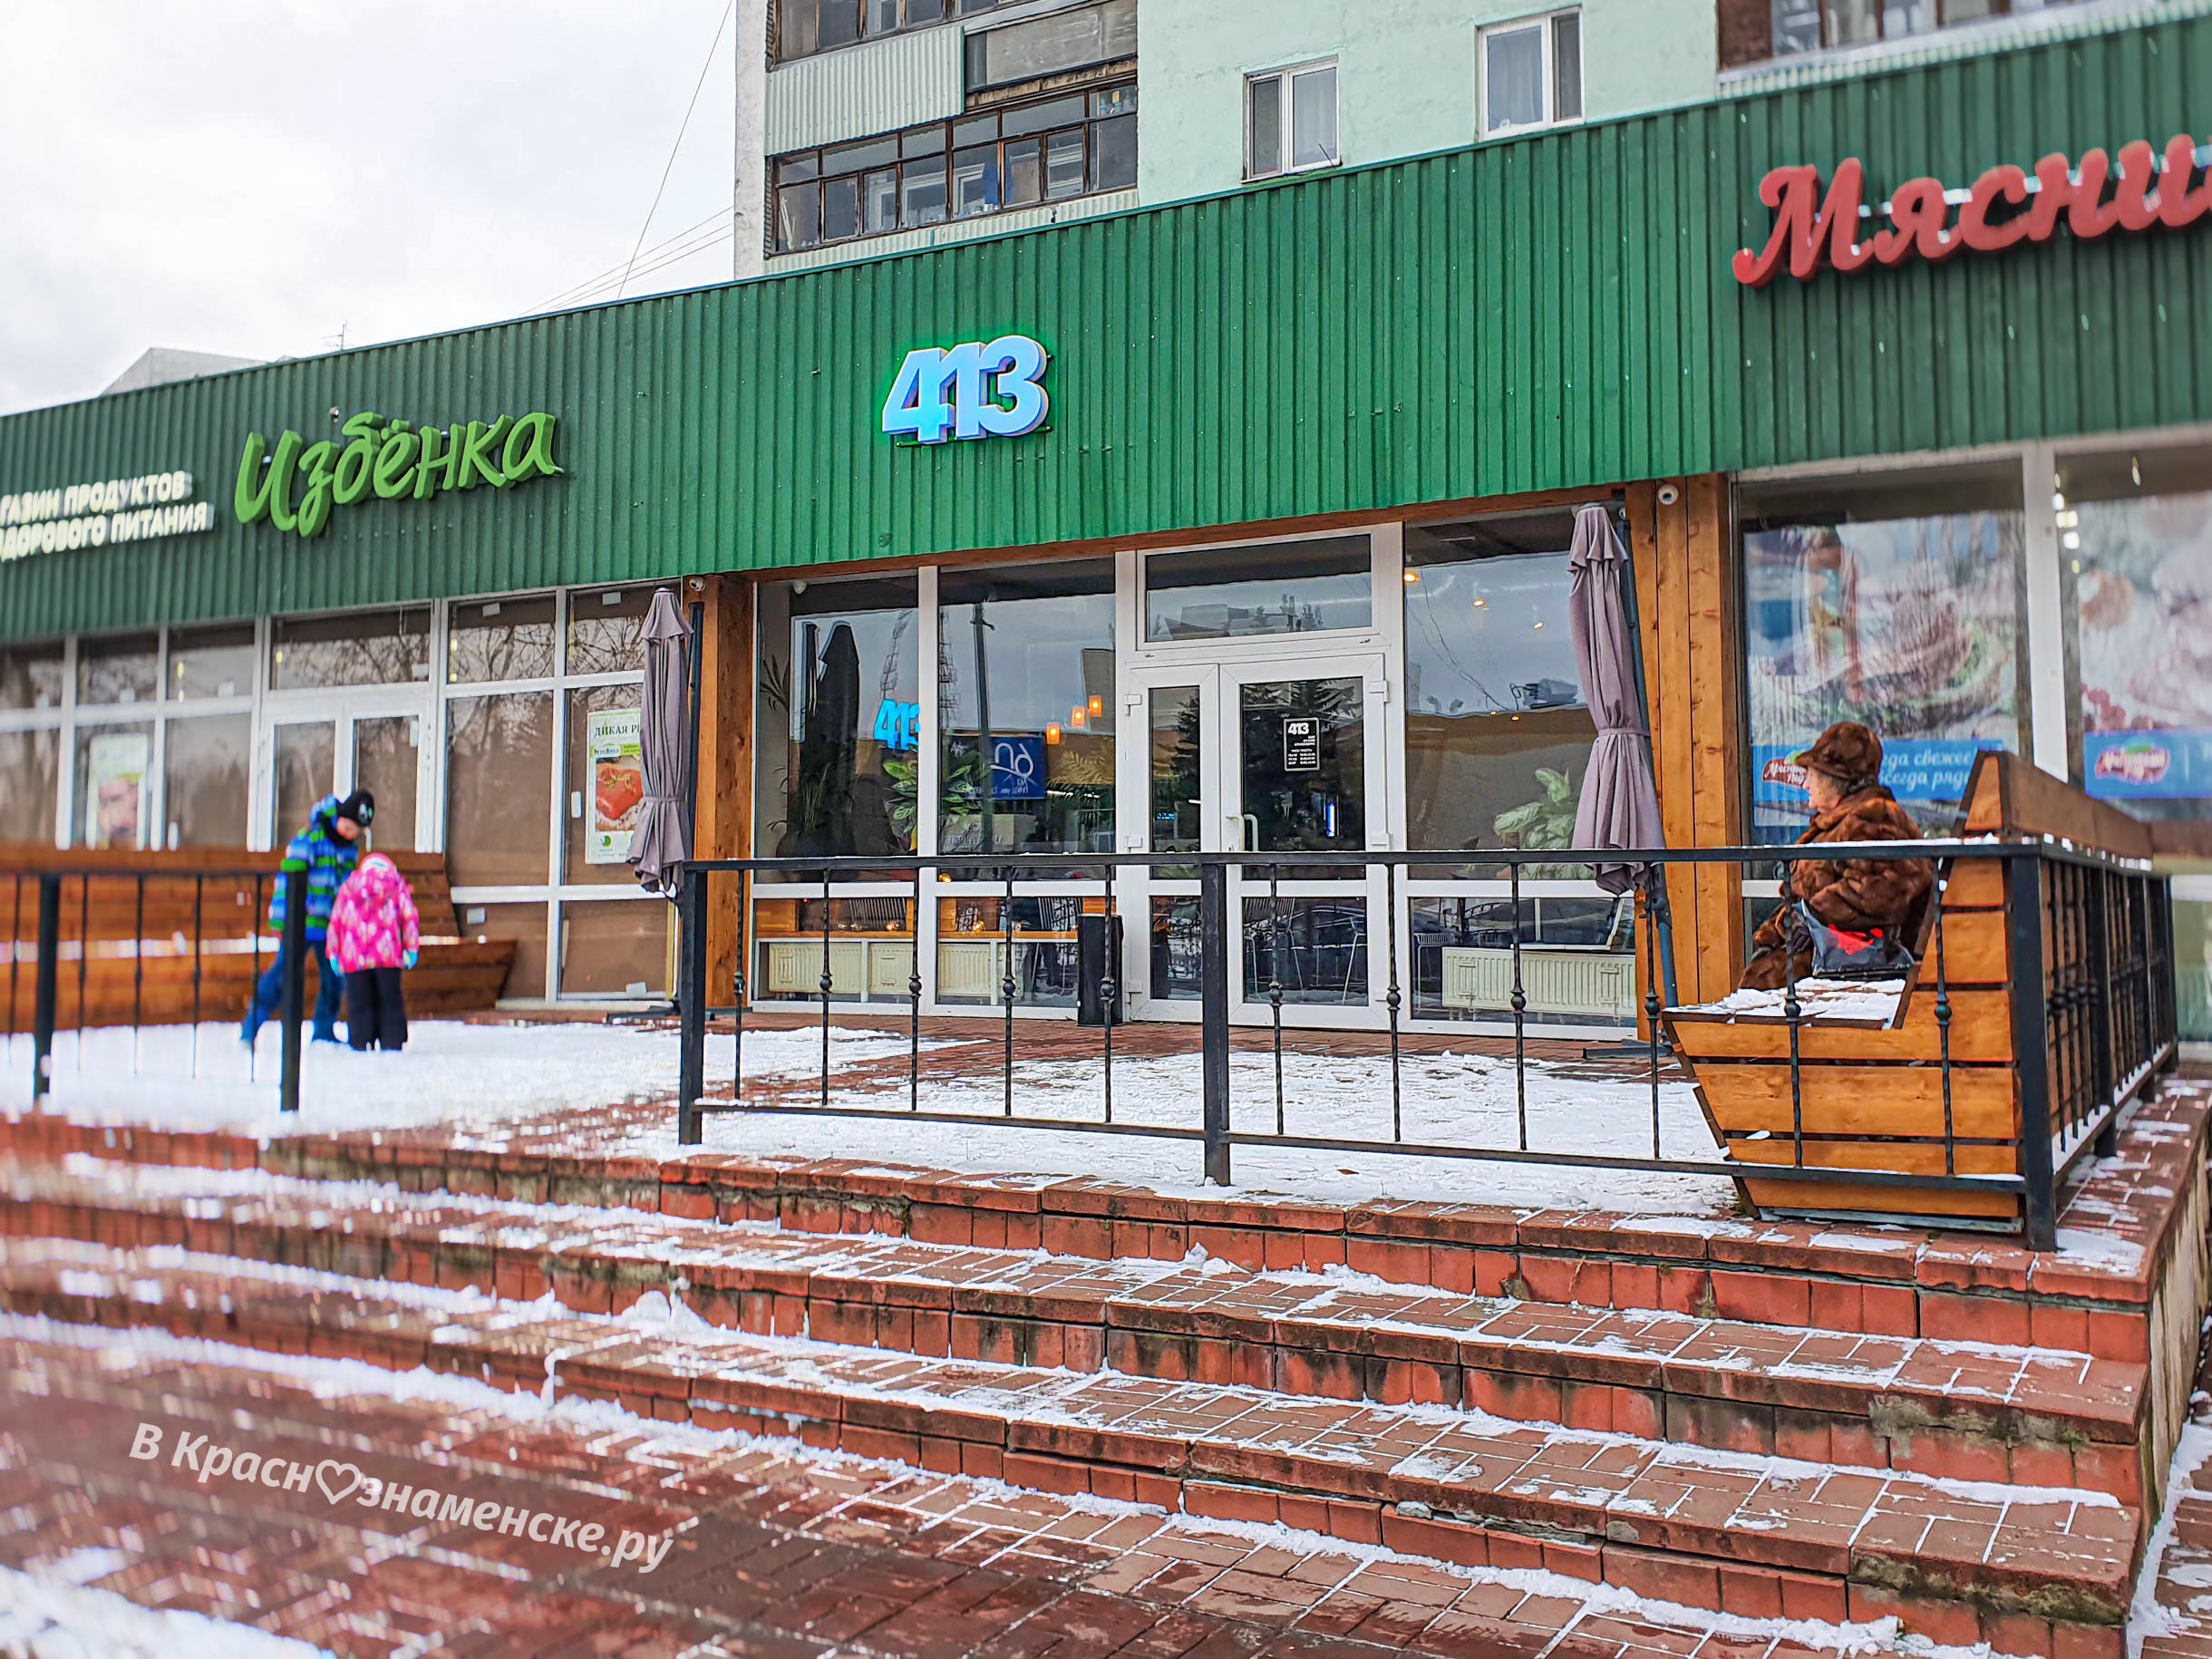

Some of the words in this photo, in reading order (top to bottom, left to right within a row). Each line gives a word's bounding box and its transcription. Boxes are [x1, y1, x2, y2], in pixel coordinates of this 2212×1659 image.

[1732, 133, 2212, 286] Мясни
[882, 335, 1050, 445] 413
[63, 470, 190, 518] ПРОДУКТОВ
[234, 411, 566, 538] Избёнка
[0, 514, 107, 564] ДОРОВОГО
[110, 501, 210, 545] ПИТАНИЯ
[594, 725, 627, 738] ДИКАЯ
[1287, 723, 1309, 735] 413
